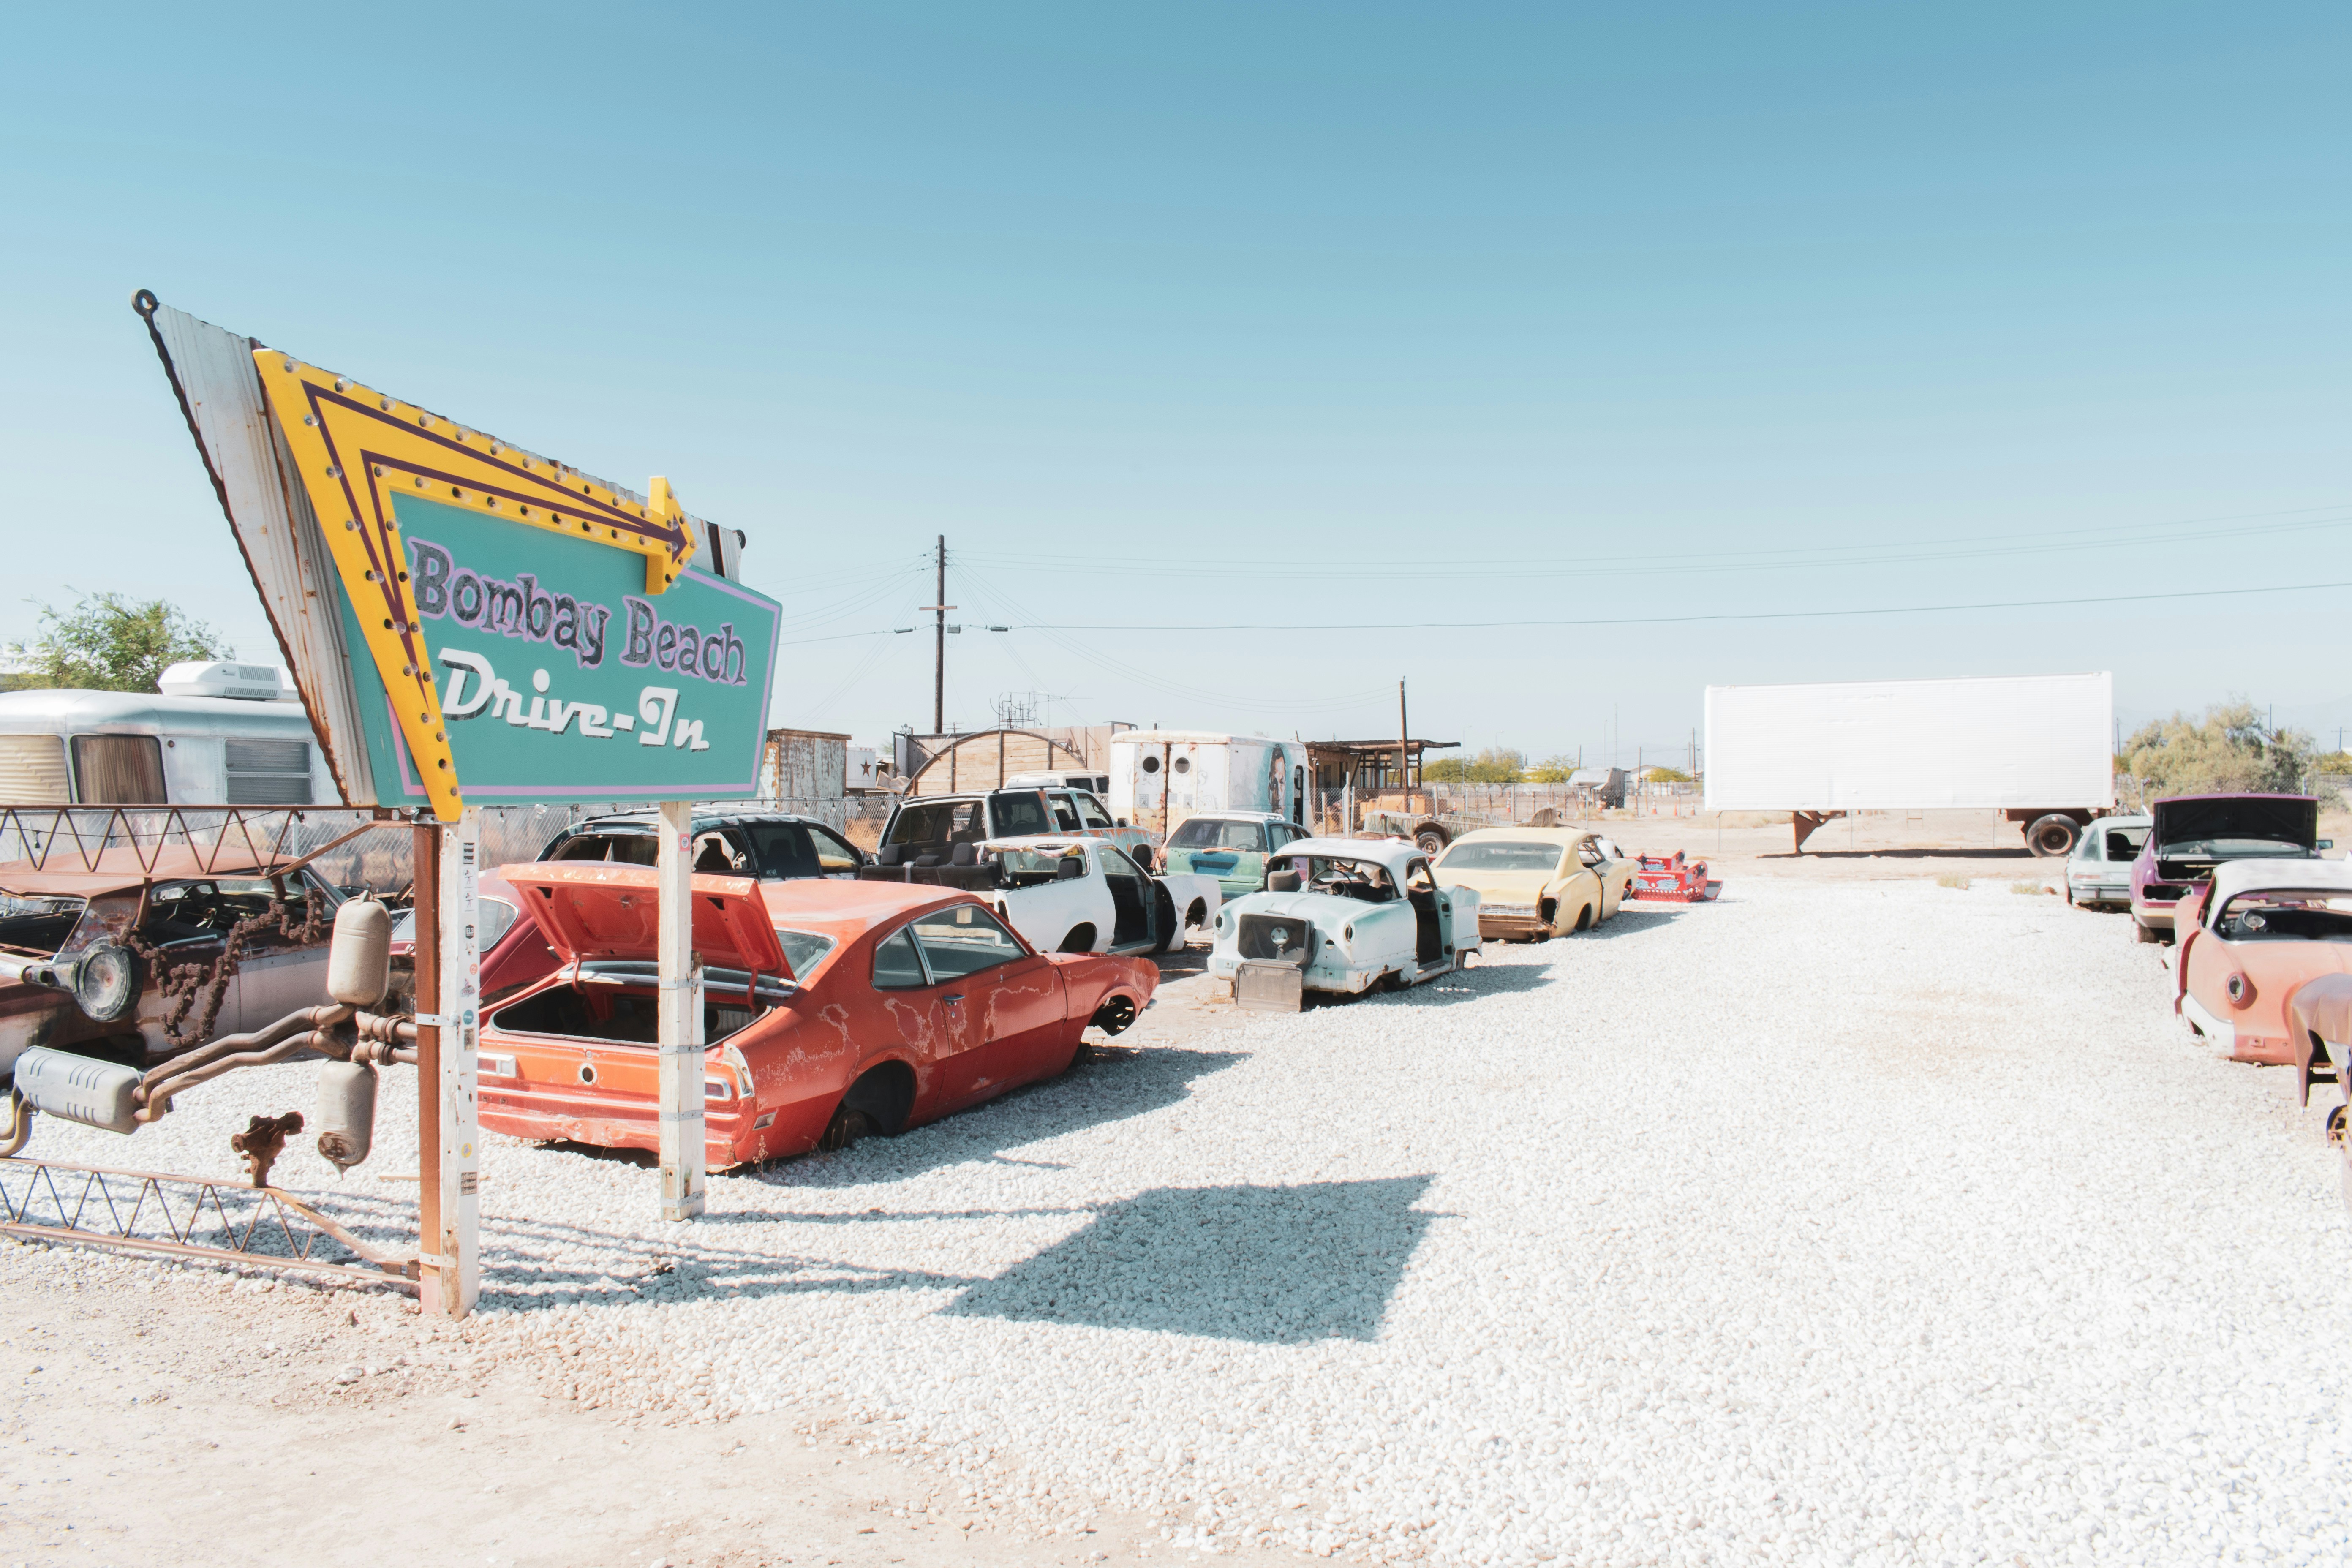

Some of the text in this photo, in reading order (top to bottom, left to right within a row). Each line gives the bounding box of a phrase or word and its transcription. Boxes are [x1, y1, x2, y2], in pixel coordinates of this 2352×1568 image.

[410, 538, 746, 685] Bombay Beach
[438, 647, 710, 752] Drive-In
